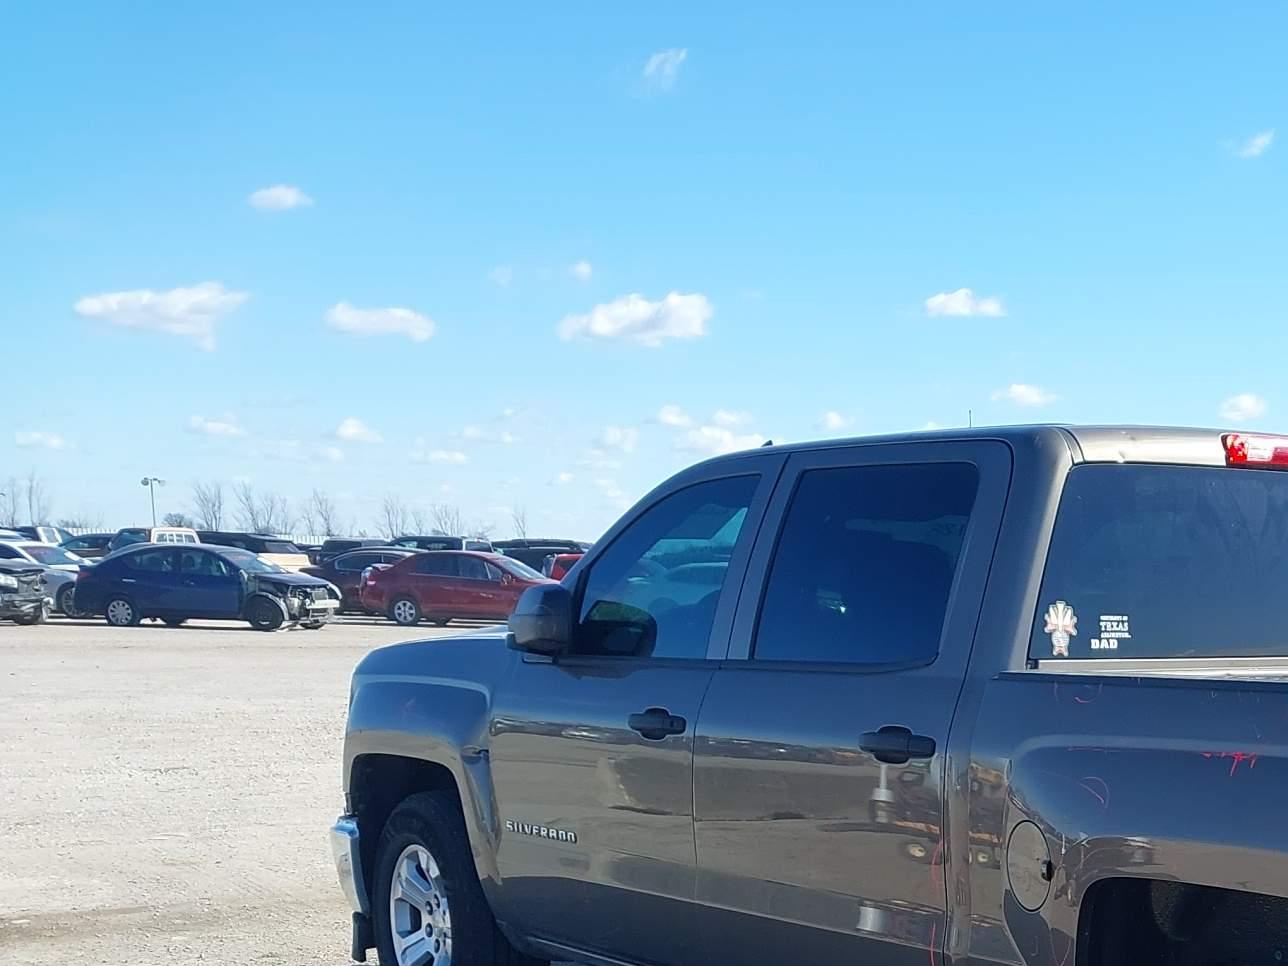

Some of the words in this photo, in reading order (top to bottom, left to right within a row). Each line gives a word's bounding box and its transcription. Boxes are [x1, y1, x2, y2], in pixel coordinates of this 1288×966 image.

[1100, 621, 1128, 631] TEXAS
[1091, 639, 1118, 648] DAD
[506, 820, 576, 842] SILVERADO
